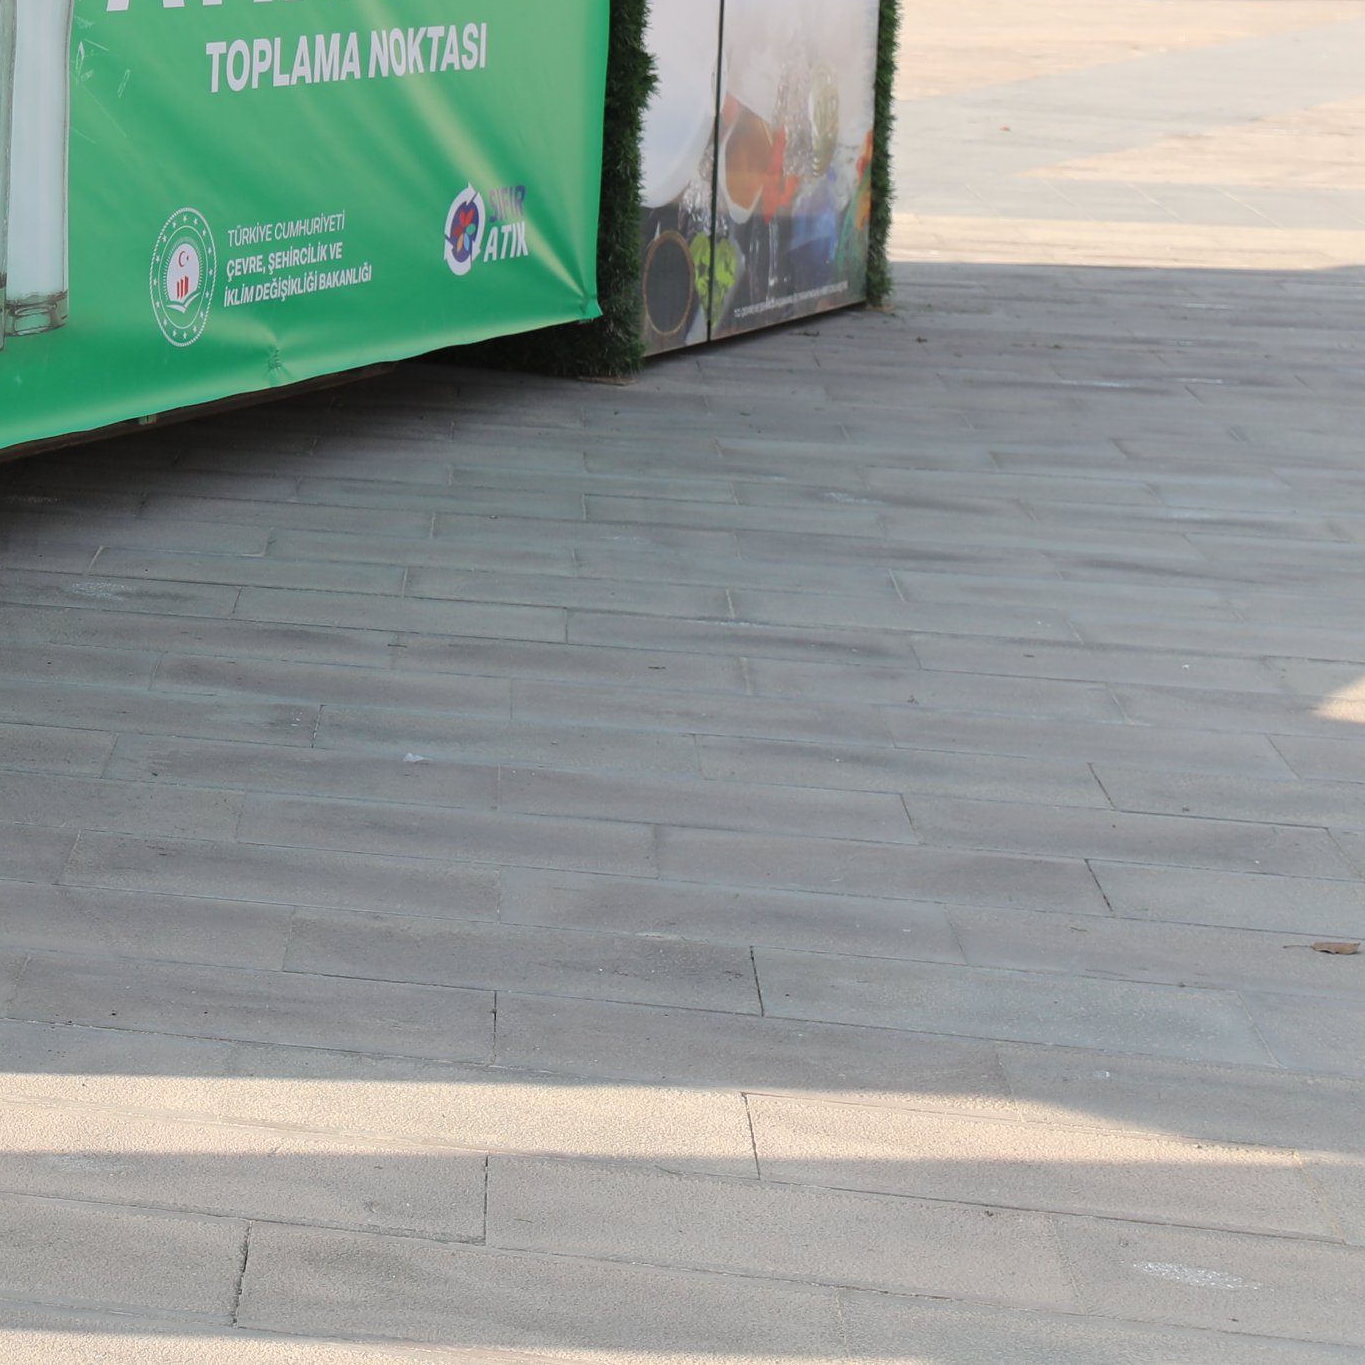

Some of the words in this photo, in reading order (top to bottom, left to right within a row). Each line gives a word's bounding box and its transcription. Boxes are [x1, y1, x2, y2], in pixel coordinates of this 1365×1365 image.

[205, 31, 362, 93] TOPLAMA
[367, 22, 487, 78] NOKTASI
[488, 185, 526, 223] SIFIR
[227, 221, 273, 248] TÜRKİYE
[274, 209, 346, 240] CUMHURİYETİ
[483, 220, 529, 263] ATIK
[226, 254, 266, 283] ÇEVRE,
[268, 241, 327, 275] ŞEHİRCİLİK
[329, 241, 343, 260] VE
[223, 282, 255, 308] İKLİM
[254, 270, 318, 302] DEĞİŞİKLİĞİ
[318, 261, 373, 290] BAKANLIĞI
